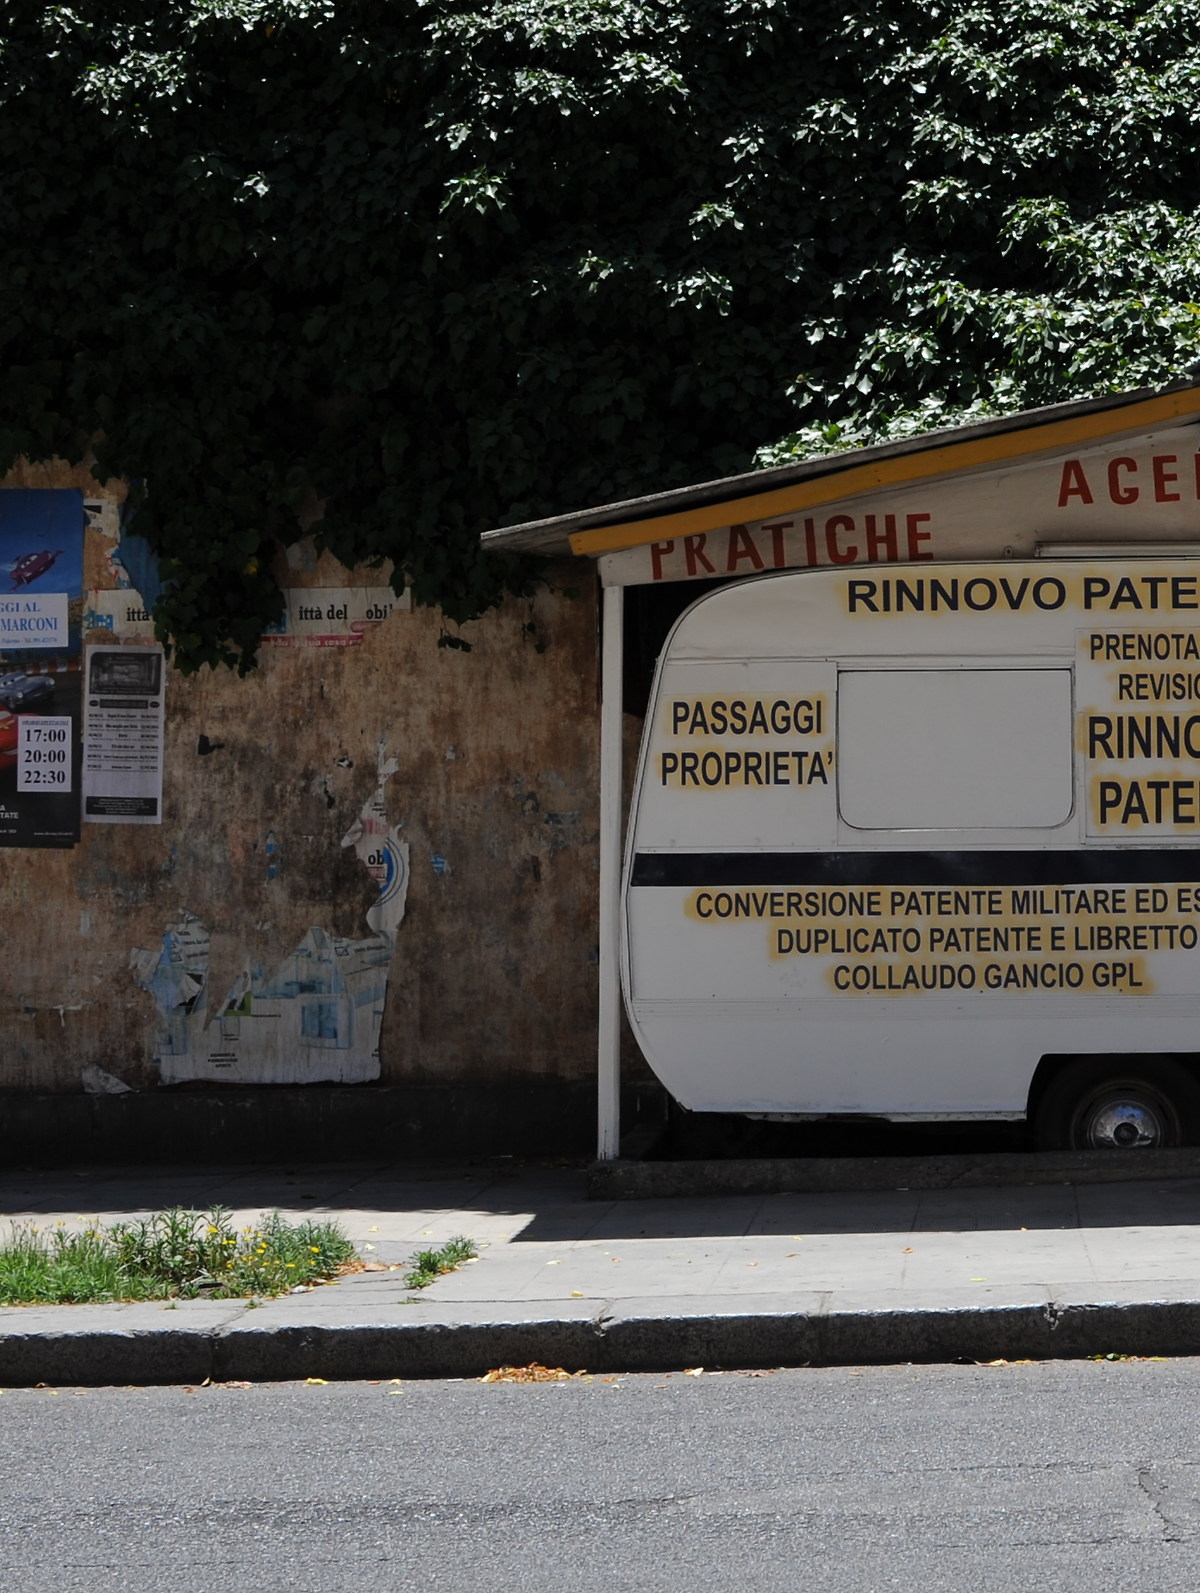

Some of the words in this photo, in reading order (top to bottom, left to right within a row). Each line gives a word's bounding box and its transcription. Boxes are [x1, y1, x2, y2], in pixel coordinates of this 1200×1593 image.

[651, 514, 933, 579] PRATICHE
[849, 577, 1066, 612] RINNOVO
[24, 602, 40, 612] AL
[327, 604, 348, 620] del
[1, 617, 58, 631] MARCONI
[673, 700, 821, 734] PASSAGGI
[26, 729, 66, 742] 17:00
[24, 749, 66, 763] 20:00
[24, 770, 66, 784] 22:30
[697, 892, 881, 917] CONVERSIONE
[891, 891, 1002, 915] PATENTE
[1012, 889, 1126, 914] MILITARE
[1136, 889, 1168, 913] ED
[778, 928, 920, 953] DUPLICATO
[930, 927, 1041, 952] PATENTE
[1051, 927, 1065, 951] E
[1075, 925, 1197, 950] LIBRETTO
[834, 964, 975, 990] COLLAUDO
[985, 963, 1083, 988] GANCIO
[1092, 963, 1142, 988] GPL
